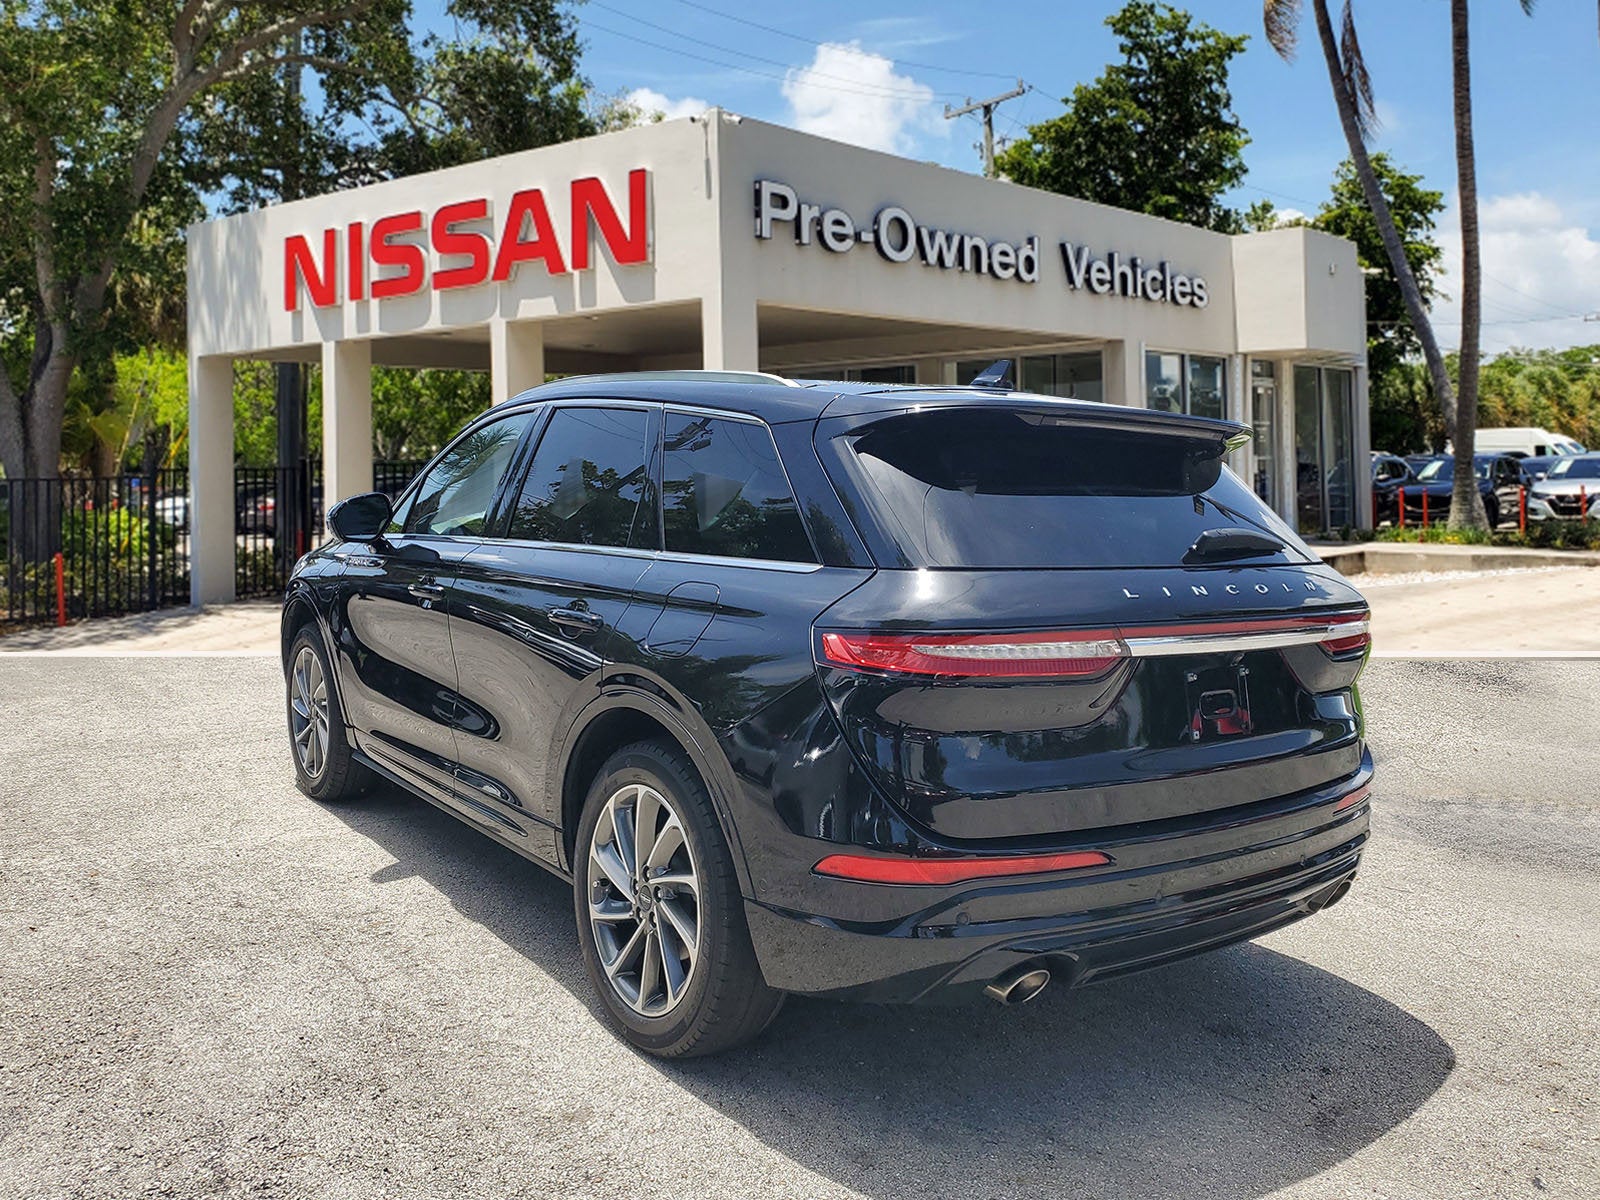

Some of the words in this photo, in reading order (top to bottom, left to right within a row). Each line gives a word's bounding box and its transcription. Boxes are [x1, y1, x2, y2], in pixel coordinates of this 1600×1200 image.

[284, 168, 648, 312] NISSAN
[754, 179, 1041, 283] Pre-Owned
[1060, 241, 1210, 308] Vehicles
[1122, 580, 1317, 599] LINCOLN
